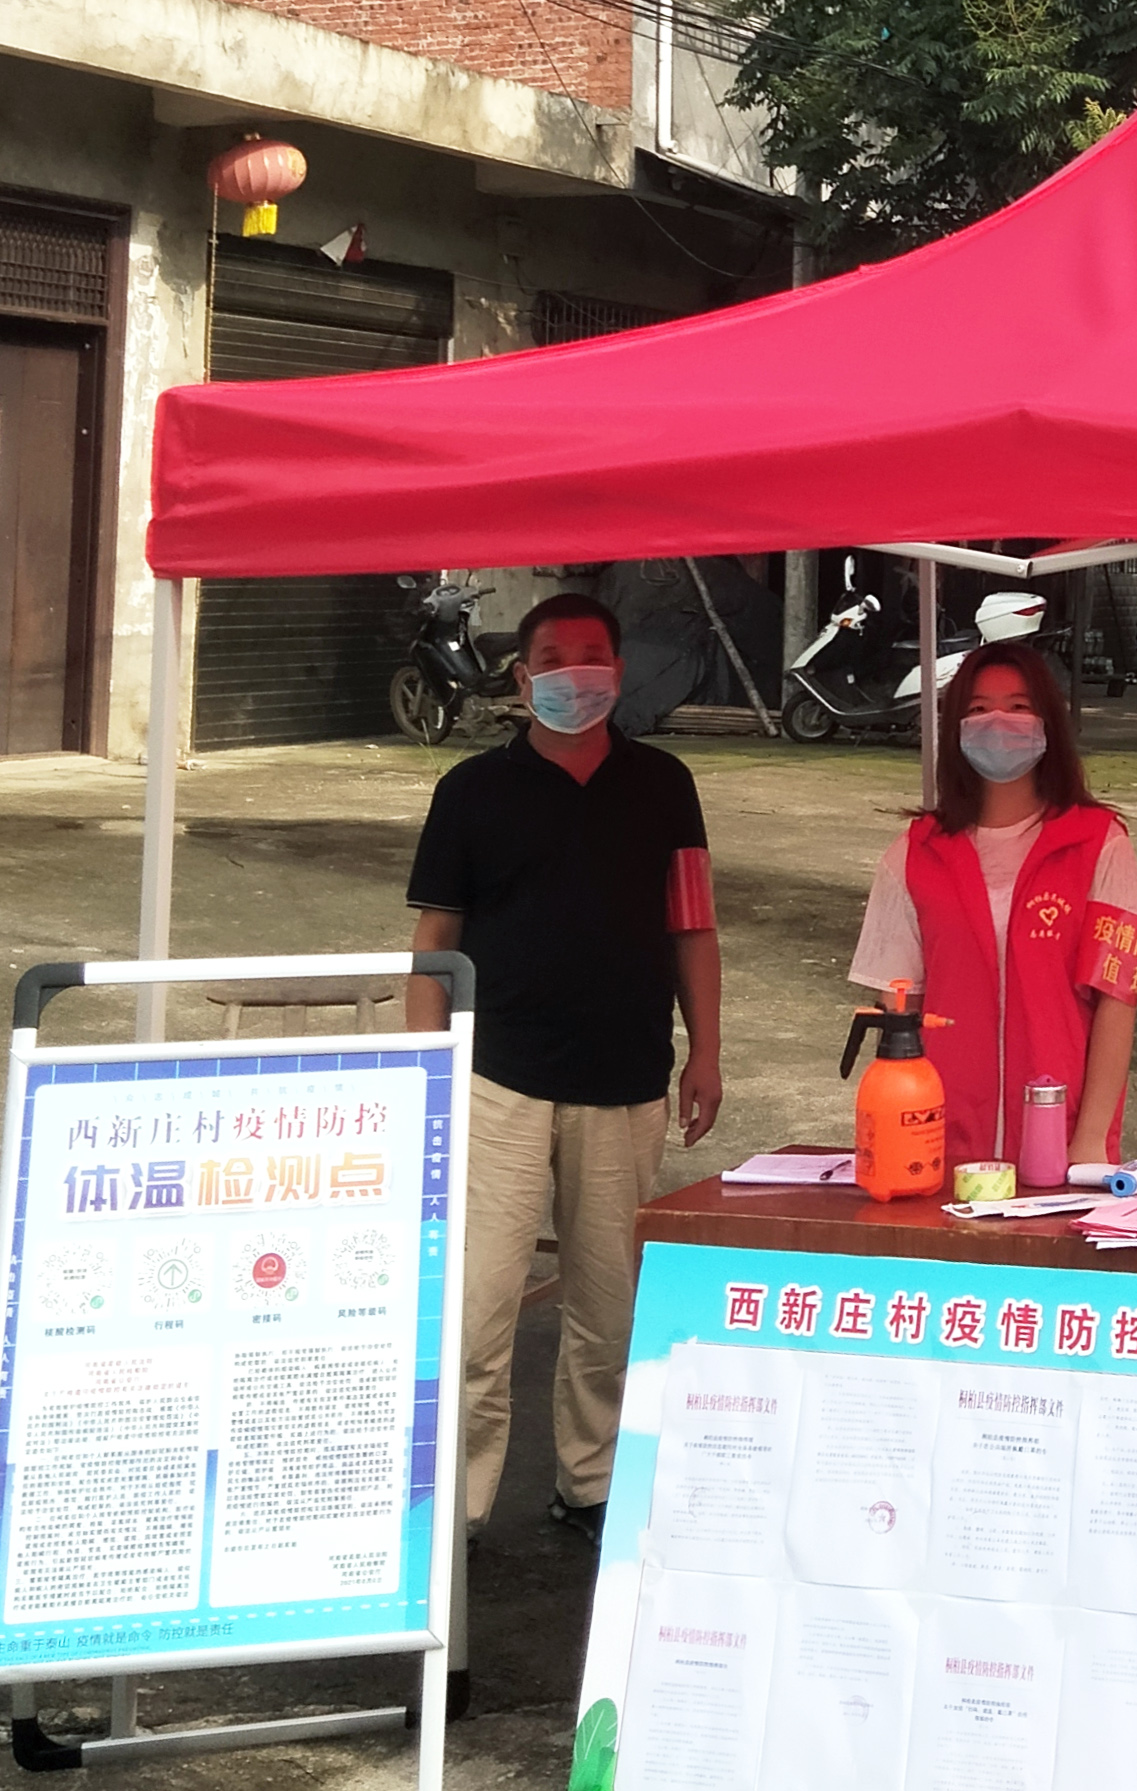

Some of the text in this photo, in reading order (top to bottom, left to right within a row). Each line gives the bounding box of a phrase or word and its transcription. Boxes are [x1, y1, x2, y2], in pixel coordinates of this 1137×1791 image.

[68, 1102, 388, 1150] 西新庄村疫情防控
[63, 1152, 386, 1214] 体温检测点
[252, 1313, 282, 1324] 密接码
[337, 1306, 387, 1319] 风险等级码
[44, 1325, 96, 1338] 核酸检测码
[154, 1319, 185, 1331] 行程码
[76, 1629, 152, 1648] 疫情就是命令
[159, 1622, 235, 1641] 防控就是责任
